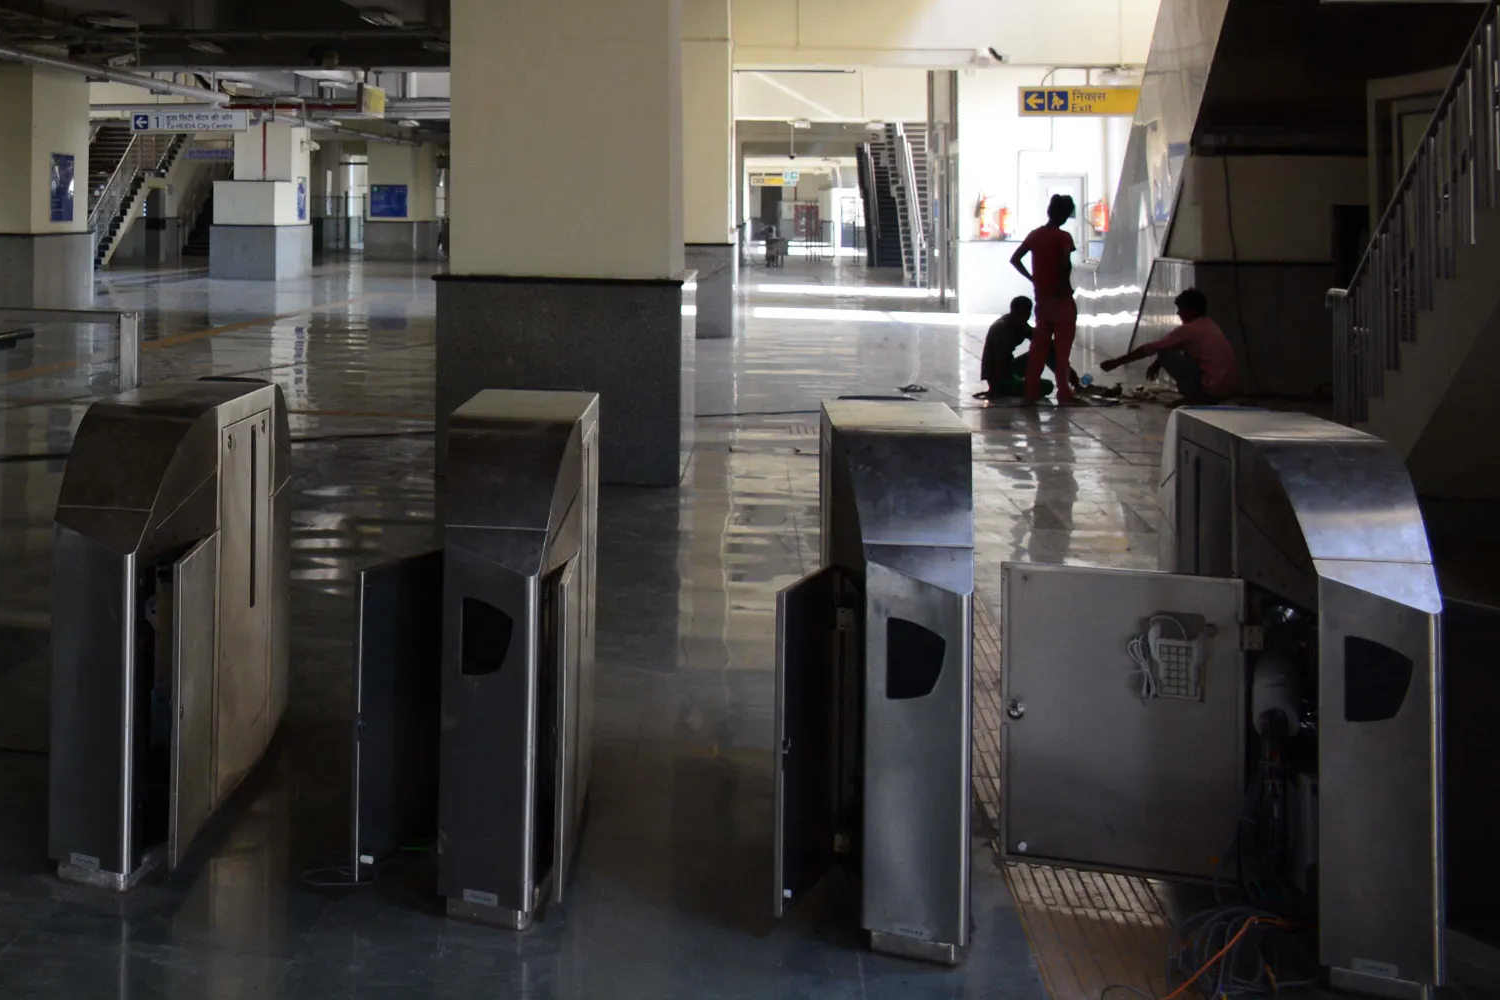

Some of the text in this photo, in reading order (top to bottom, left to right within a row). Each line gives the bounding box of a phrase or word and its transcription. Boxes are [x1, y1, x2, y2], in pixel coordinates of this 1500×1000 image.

[1072, 89, 1107, 102] निकास
[1071, 104, 1092, 113] Exit
[154, 116, 160, 129] 1
[197, 123, 210, 131] City
